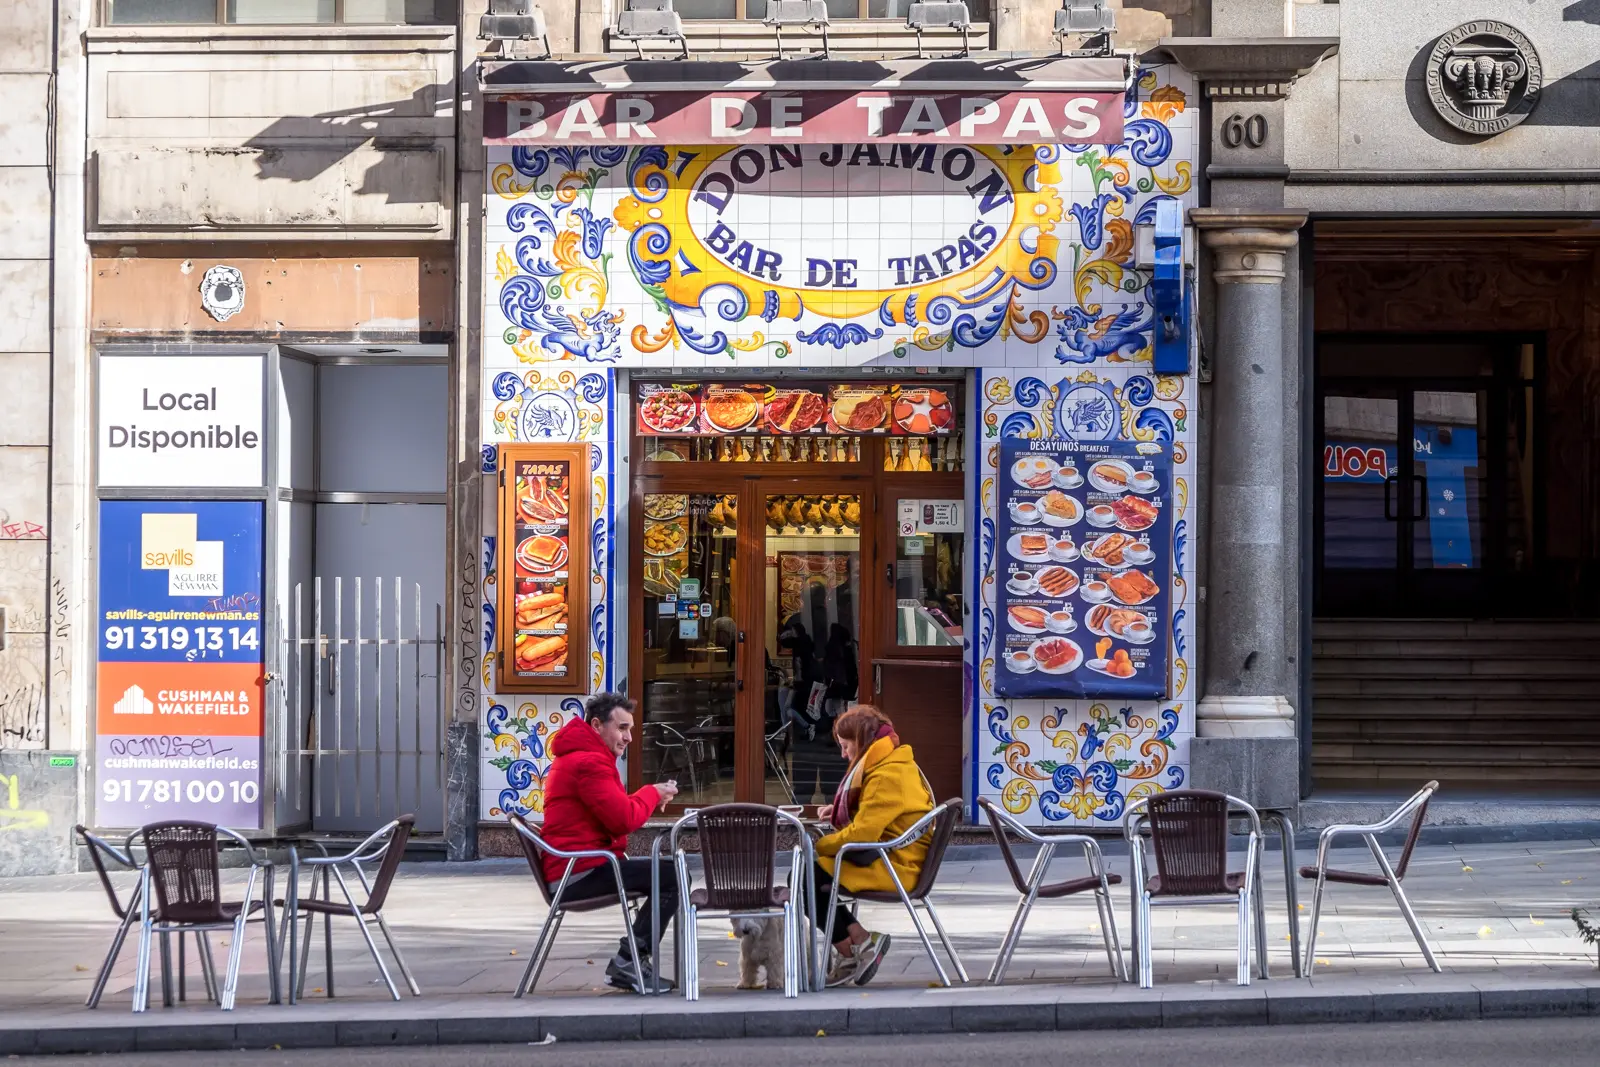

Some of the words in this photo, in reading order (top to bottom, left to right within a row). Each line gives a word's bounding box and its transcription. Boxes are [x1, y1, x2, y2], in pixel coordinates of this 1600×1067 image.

[1432, 22, 1478, 63] HISPANO
[1484, 20, 1503, 34] DE
[507, 98, 657, 139] BAR
[710, 97, 803, 137] DE
[856, 97, 1101, 138] TAPAS
[1458, 116, 1510, 133] MADRID
[1226, 112, 1269, 148] 60
[694, 144, 804, 216] DON
[703, 220, 783, 282] BAR
[804, 257, 857, 288] DE
[888, 219, 998, 286] TAPAS
[142, 387, 216, 411] Local
[108, 425, 258, 453] Disponible
[1030, 441, 1079, 451] DESAYUNOS
[1079, 445, 1109, 453] BREAKFAST
[522, 464, 564, 475] TAPAS
[145, 548, 193, 566] savills
[172, 582, 219, 590] NEWMAN
[173, 573, 218, 582] AGUIRRE
[105, 609, 259, 621] savills-aguirrenewman.es
[105, 626, 134, 650] 91
[140, 626, 189, 650] 319
[194, 626, 223, 650] 13
[228, 626, 259, 650] 14
[157, 690, 235, 702] CUSHMAN
[238, 691, 249, 702] &
[157, 703, 250, 715] WAKEFIELD
[104, 756, 258, 770] cushmanwakefield.es
[103, 779, 131, 803] 91
[137, 779, 181, 803] 781
[186, 780, 225, 803] 00
[229, 780, 259, 803] 10
